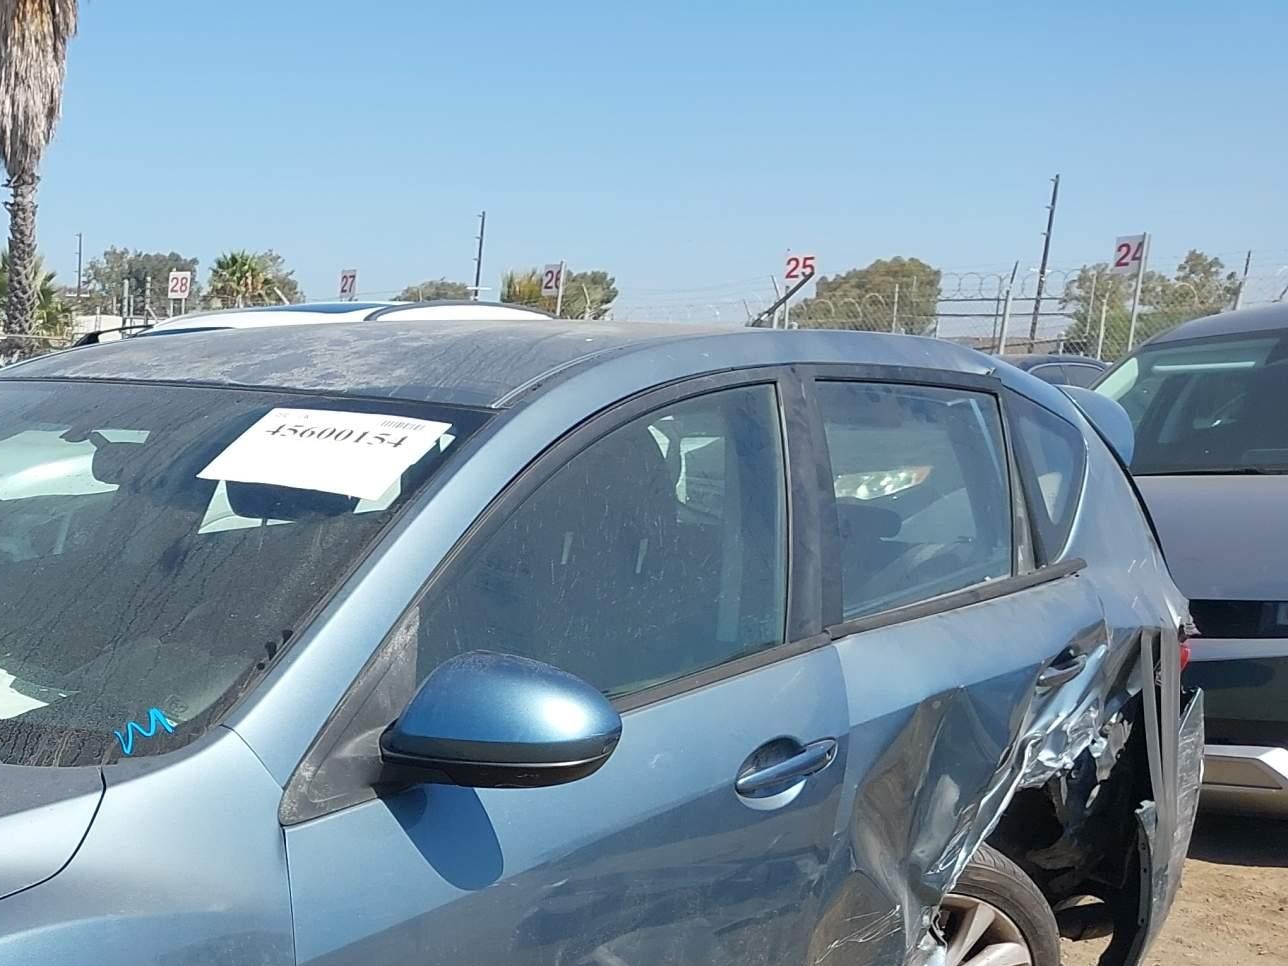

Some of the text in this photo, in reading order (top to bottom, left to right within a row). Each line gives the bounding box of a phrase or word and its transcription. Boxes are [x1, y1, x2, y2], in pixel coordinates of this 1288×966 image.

[1115, 241, 1143, 267] 24
[785, 256, 816, 279] 25
[170, 276, 189, 293] 28
[341, 275, 356, 293] 27
[265, 423, 409, 448] 45600154
